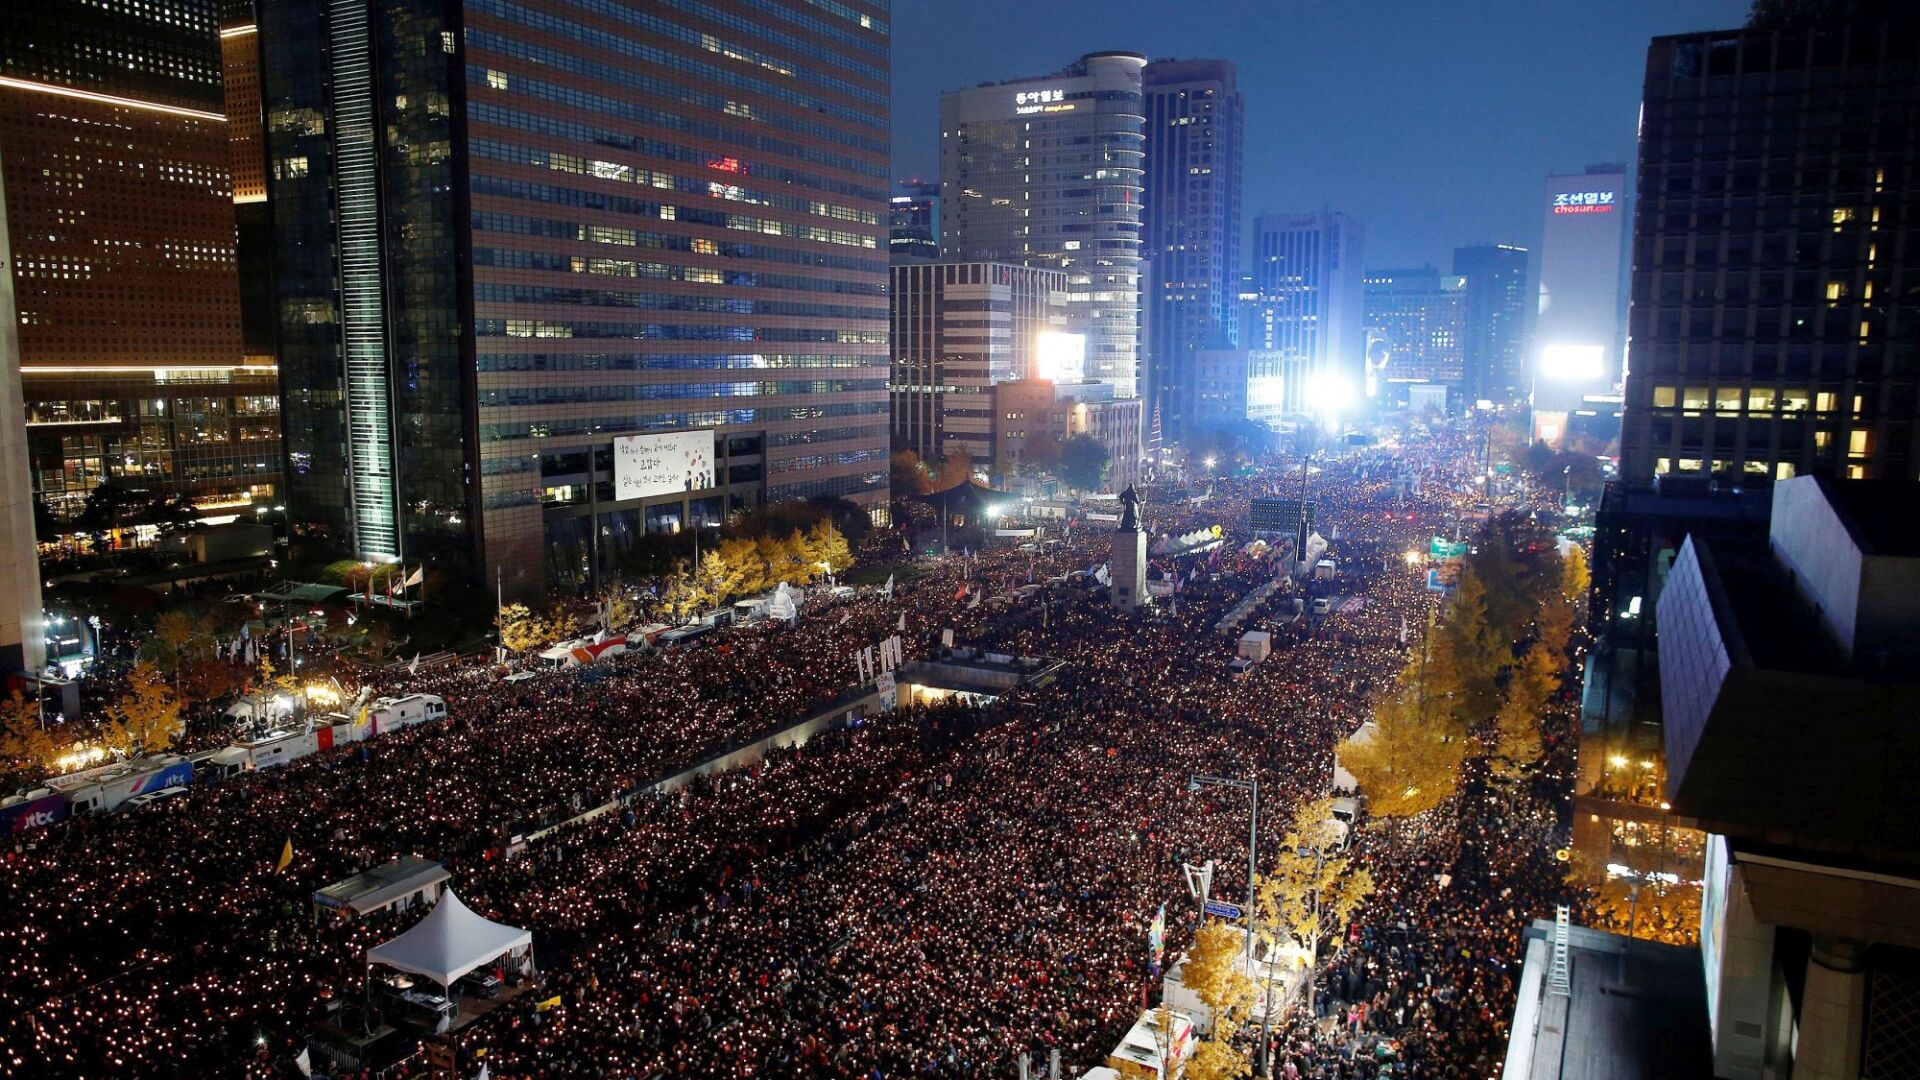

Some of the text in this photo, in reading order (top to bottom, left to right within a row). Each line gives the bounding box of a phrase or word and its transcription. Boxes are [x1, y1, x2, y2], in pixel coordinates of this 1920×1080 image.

[1016, 89, 1064, 104] 동아일보
[1553, 192, 1614, 206] 조선일보
[1554, 205, 1612, 214] chosun.com
